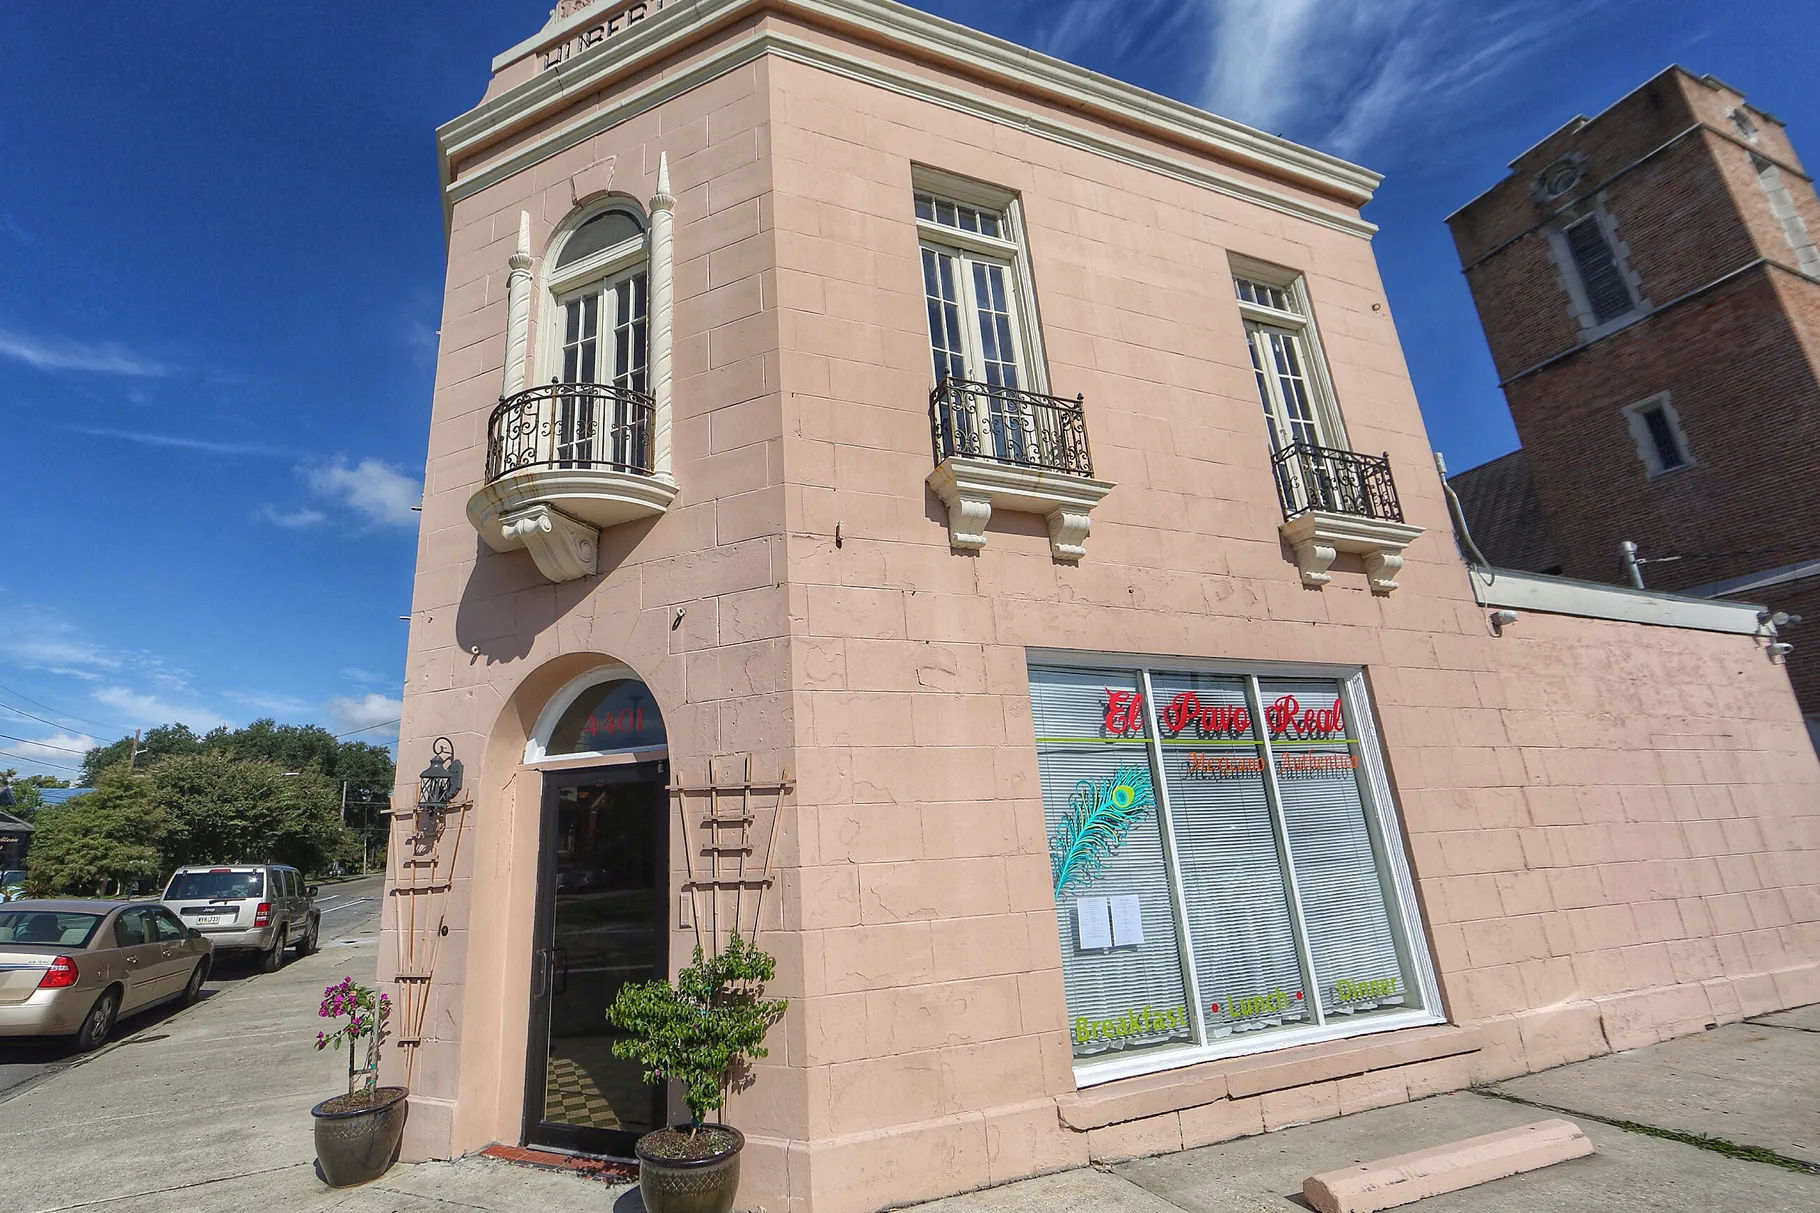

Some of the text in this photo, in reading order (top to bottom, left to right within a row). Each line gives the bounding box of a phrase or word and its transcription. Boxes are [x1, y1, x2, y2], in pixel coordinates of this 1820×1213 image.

[582, 707, 643, 737] 4401
[1105, 685, 1345, 734] El Pavo Real
[1186, 749, 1358, 776] Mexicano Authentico
[1075, 977, 1397, 1042] Breakfast Lunch Dinner
